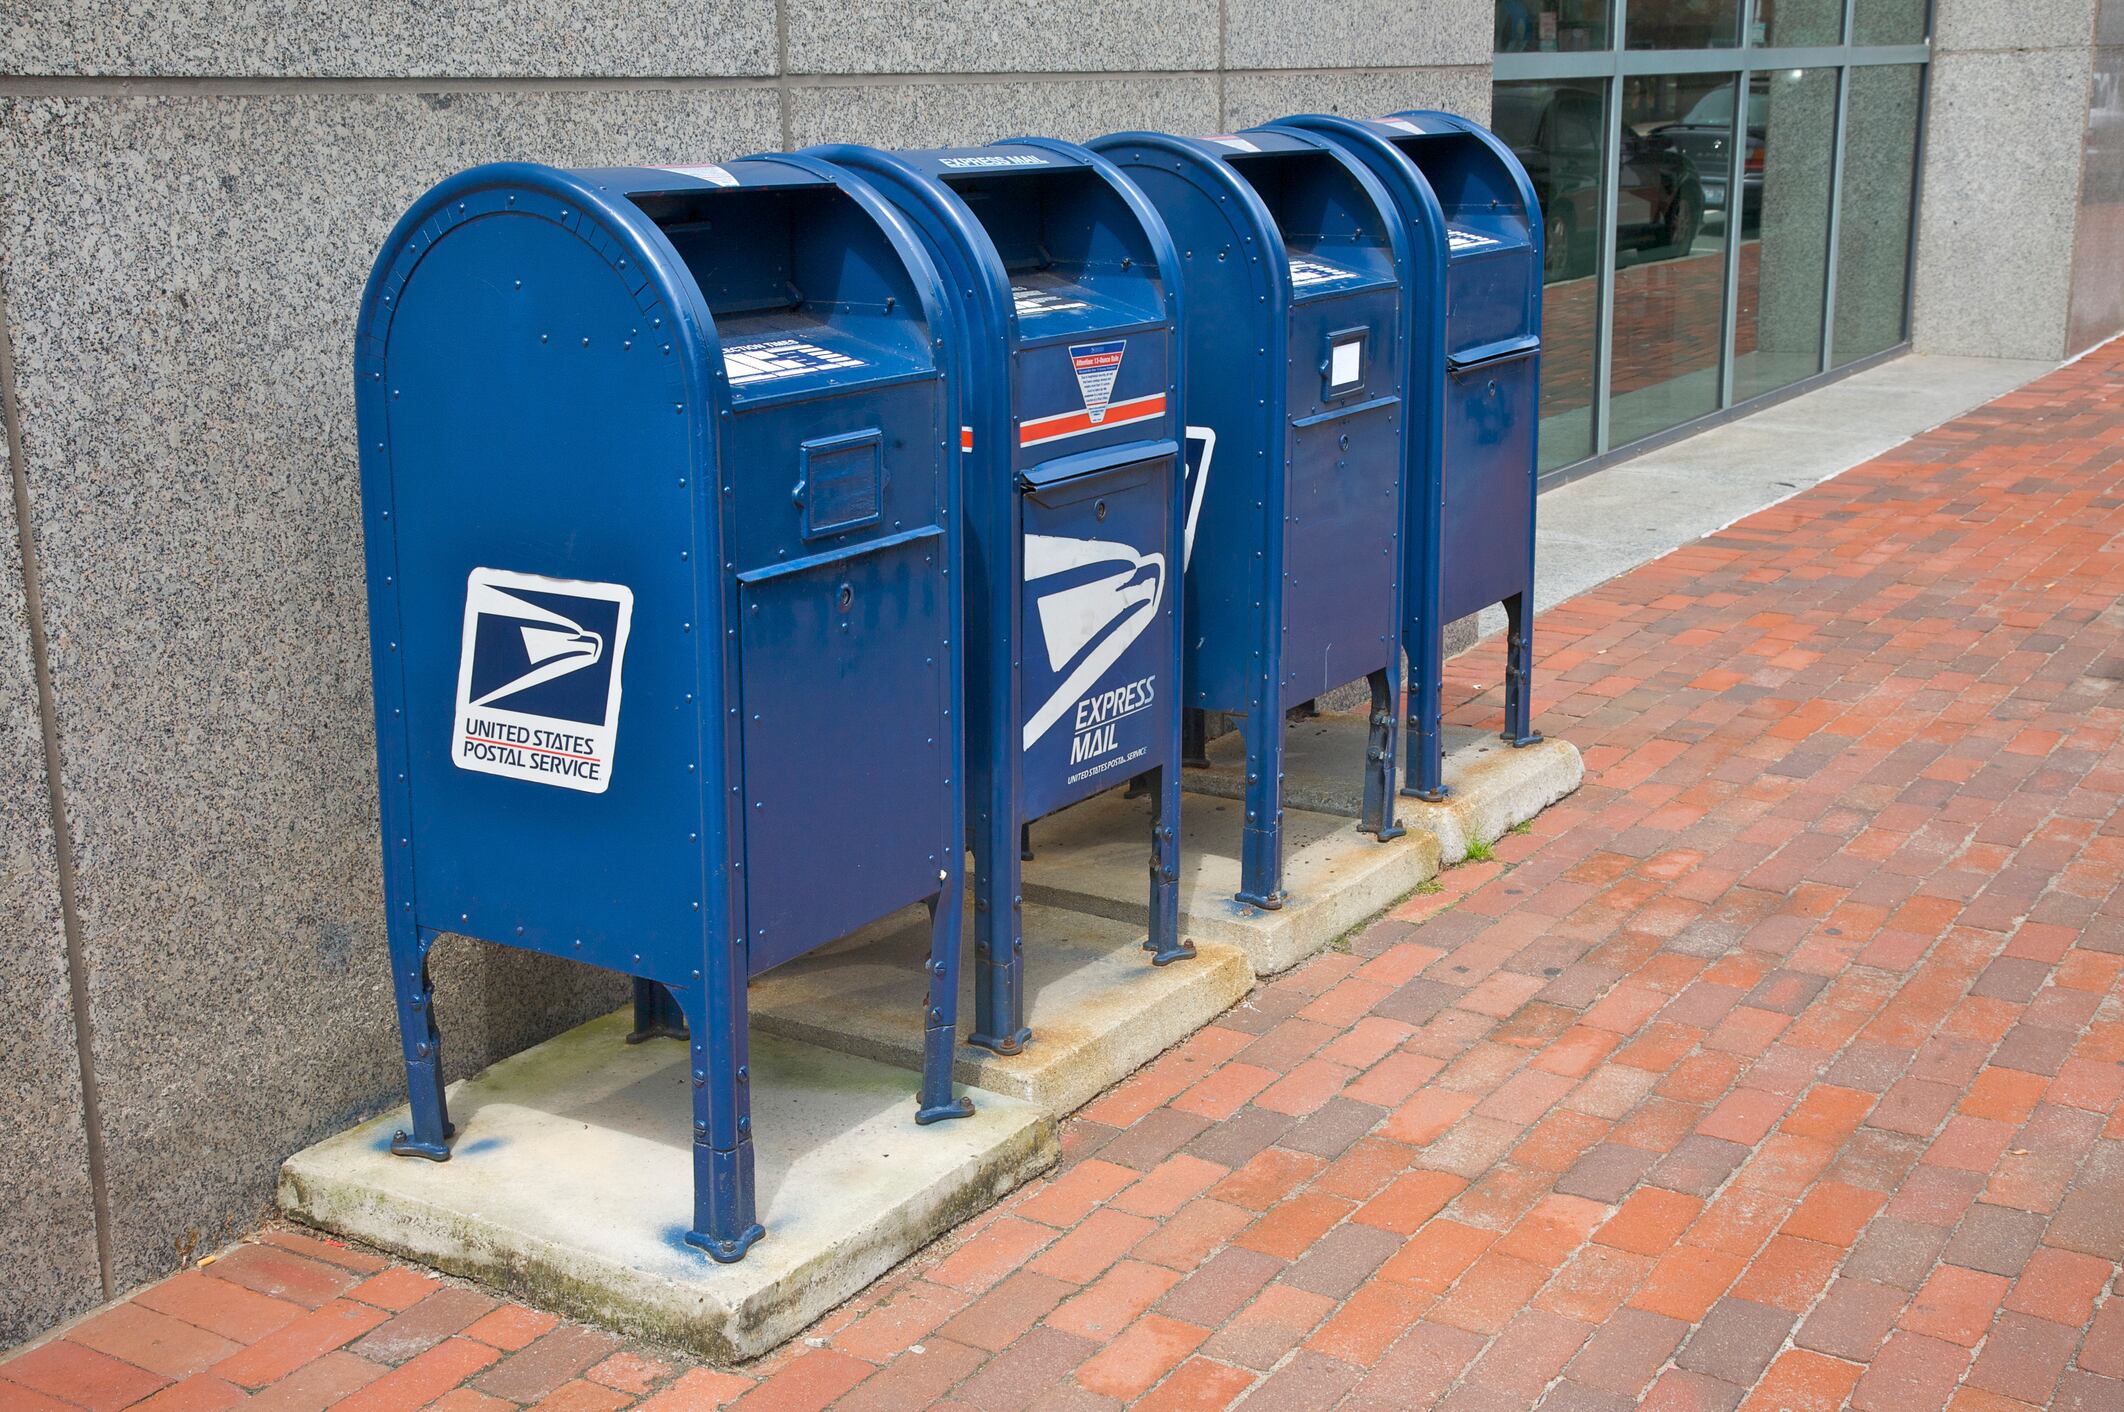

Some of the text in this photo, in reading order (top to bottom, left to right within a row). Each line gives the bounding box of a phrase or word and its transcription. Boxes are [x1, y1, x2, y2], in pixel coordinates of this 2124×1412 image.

[938, 154, 1050, 168] EXPRESS MAIL
[1075, 675, 1156, 730] EXPRESS
[465, 717, 594, 755] UNITED STATES
[1070, 724, 1119, 765] MAIL
[463, 740, 600, 780] POSTAL SERVICE
[1067, 746, 1148, 785] UNITED STATES POSTAL SERVICE
